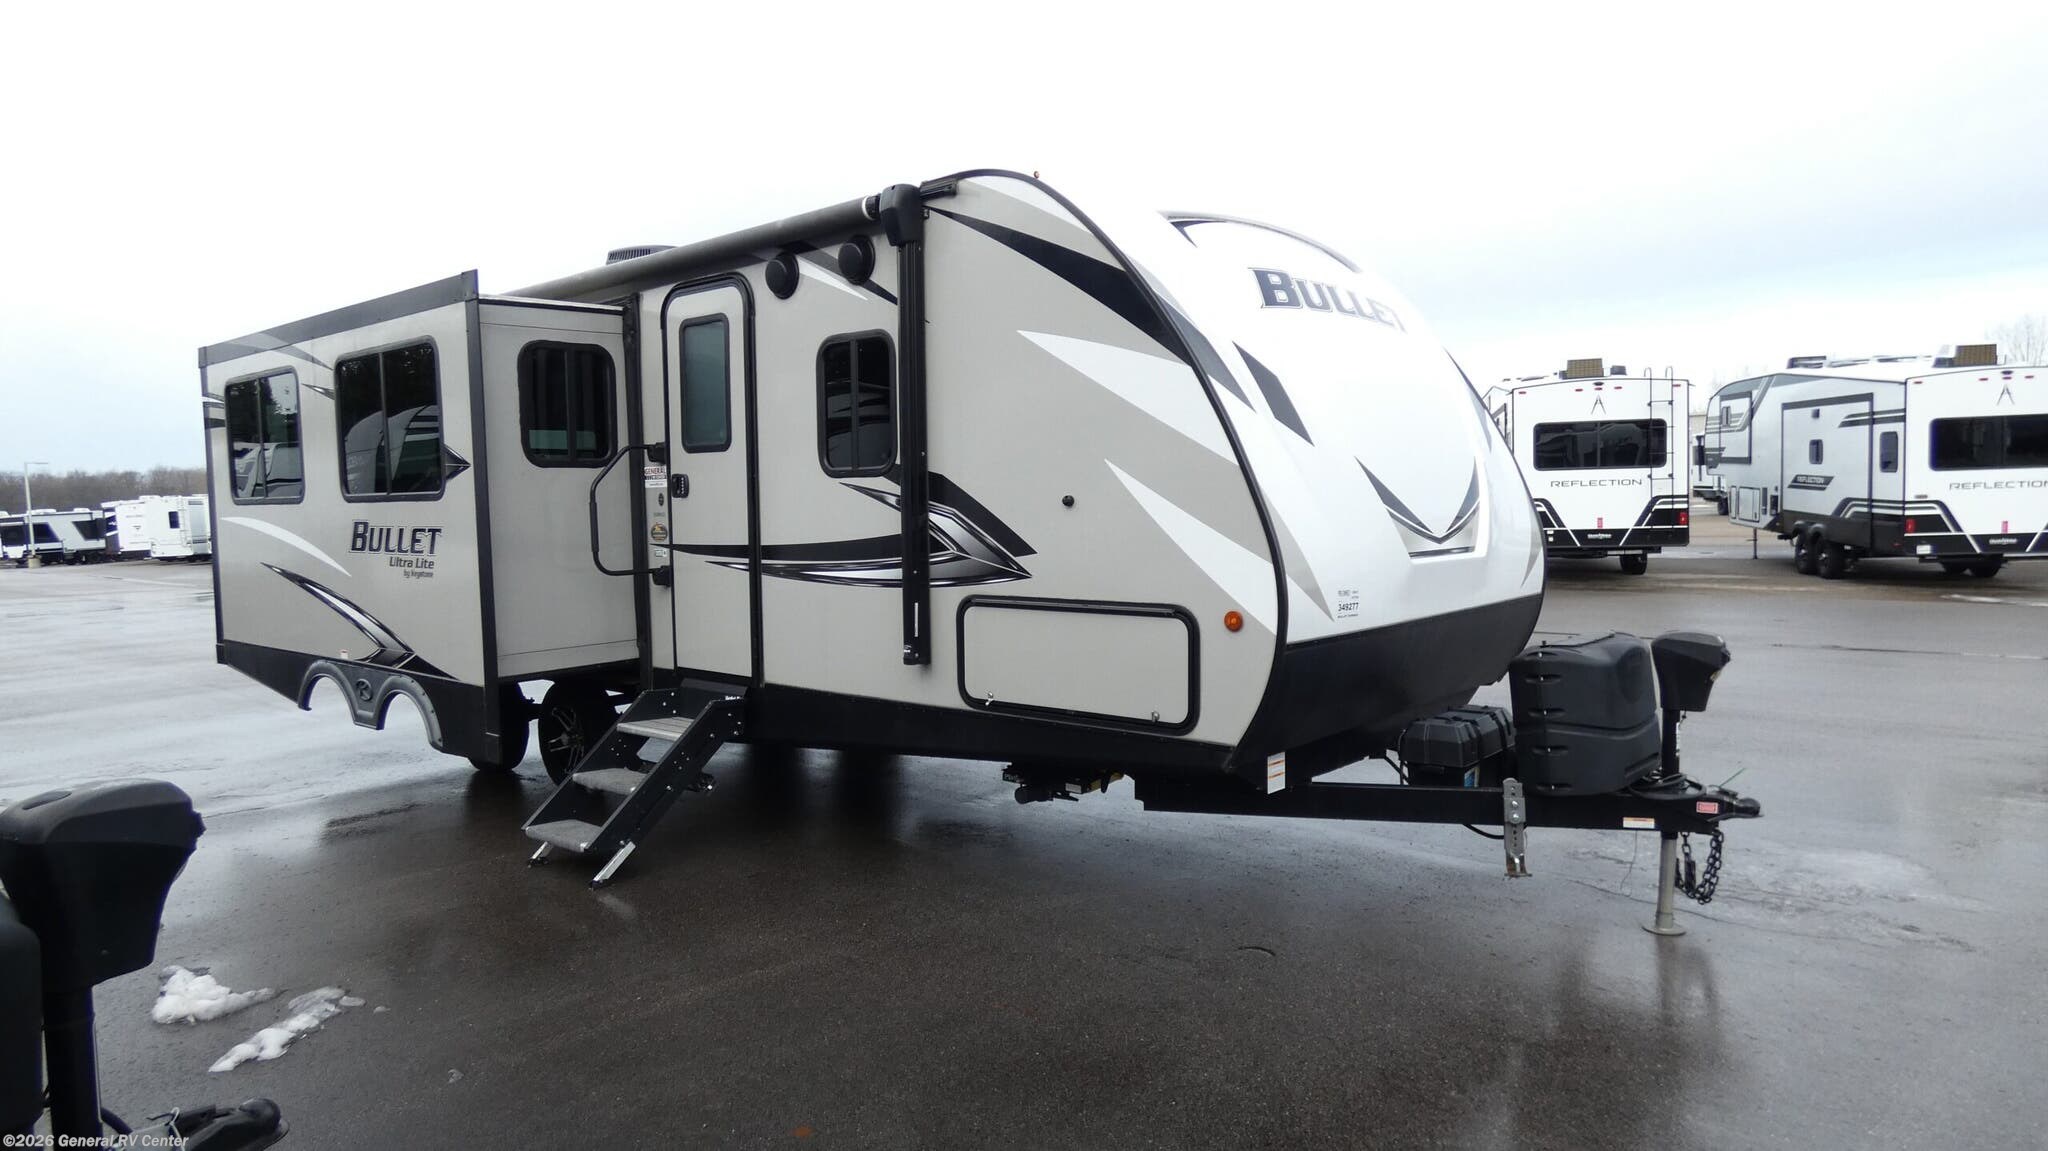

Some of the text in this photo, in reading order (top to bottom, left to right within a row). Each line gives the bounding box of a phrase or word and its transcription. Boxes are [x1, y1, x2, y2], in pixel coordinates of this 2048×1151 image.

[1550, 479, 1642, 487] REFLECTION
[350, 520, 443, 555] BULLET
[389, 557, 434, 569] Ultra Lite
[1338, 602, 1359, 611] 349277
